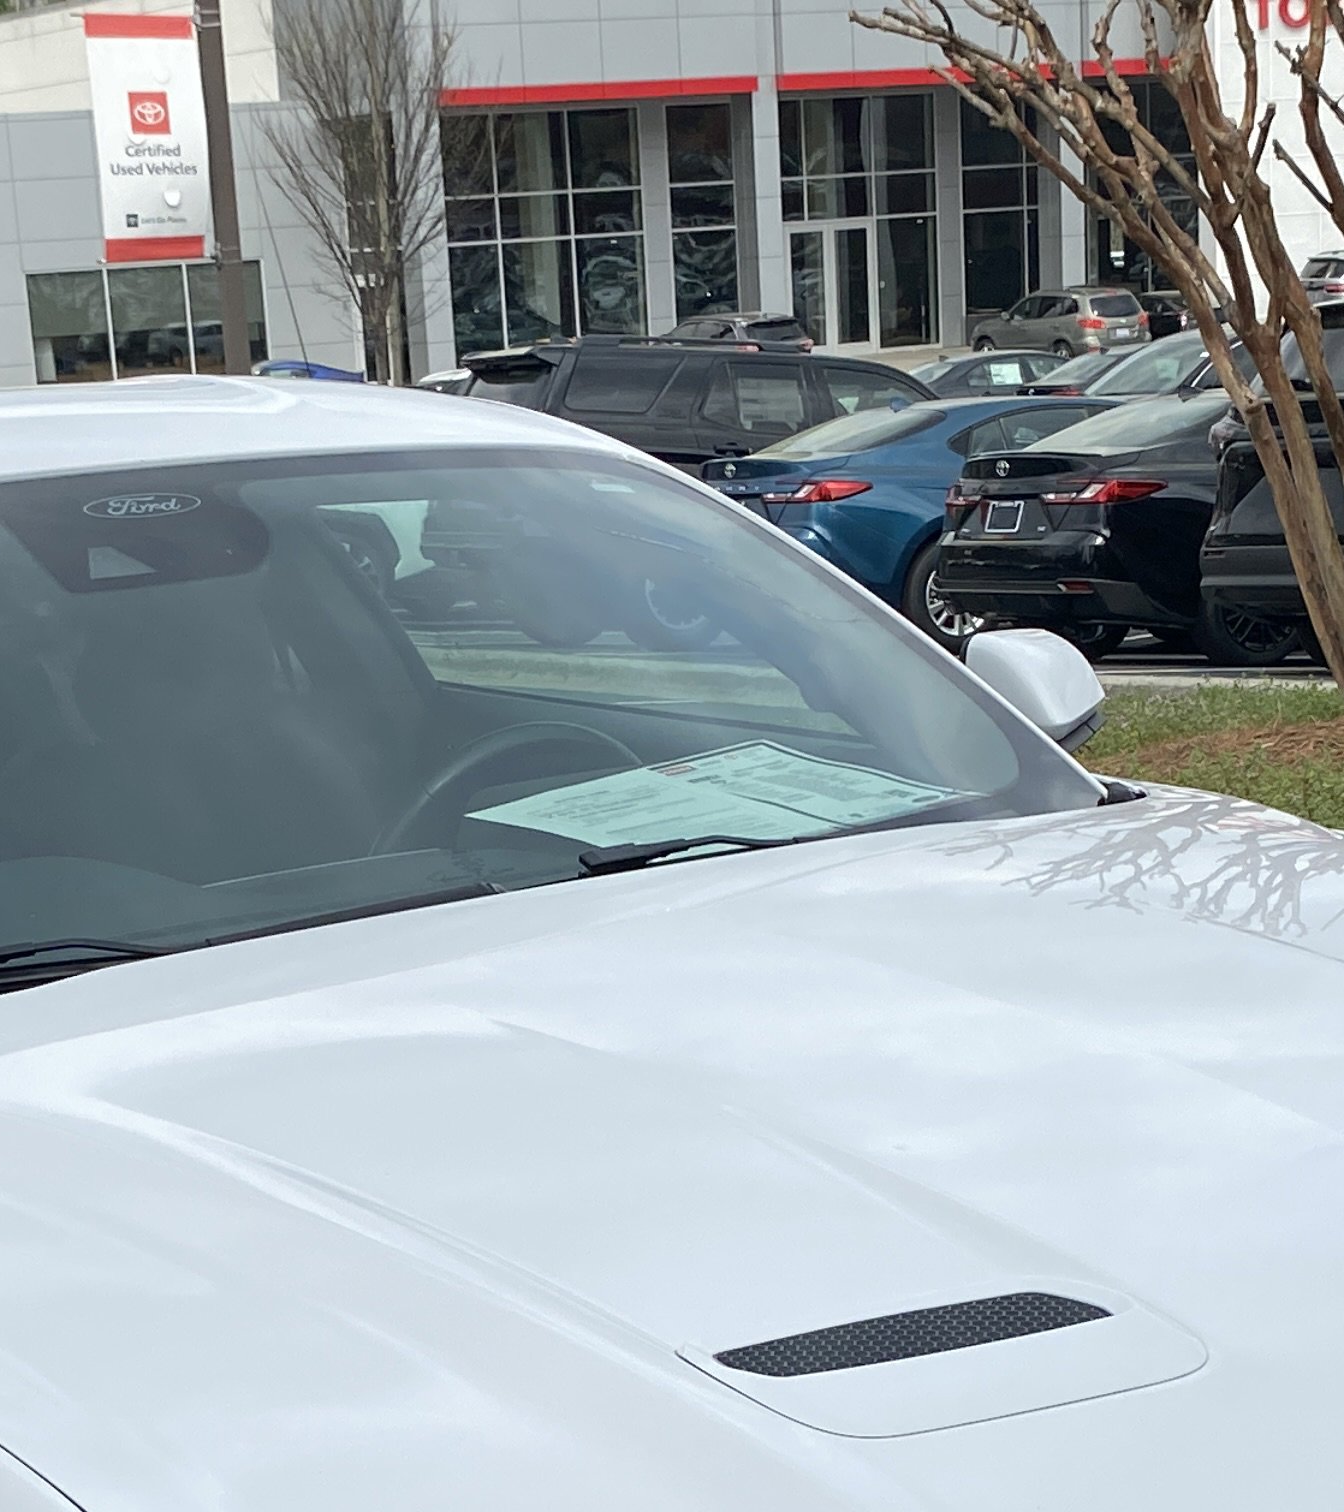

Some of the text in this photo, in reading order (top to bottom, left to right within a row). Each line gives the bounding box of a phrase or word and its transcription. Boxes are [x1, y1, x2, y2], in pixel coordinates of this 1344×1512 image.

[125, 144, 181, 157] Certified
[110, 162, 198, 176] Used Vehicles
[106, 495, 181, 516] Ford
